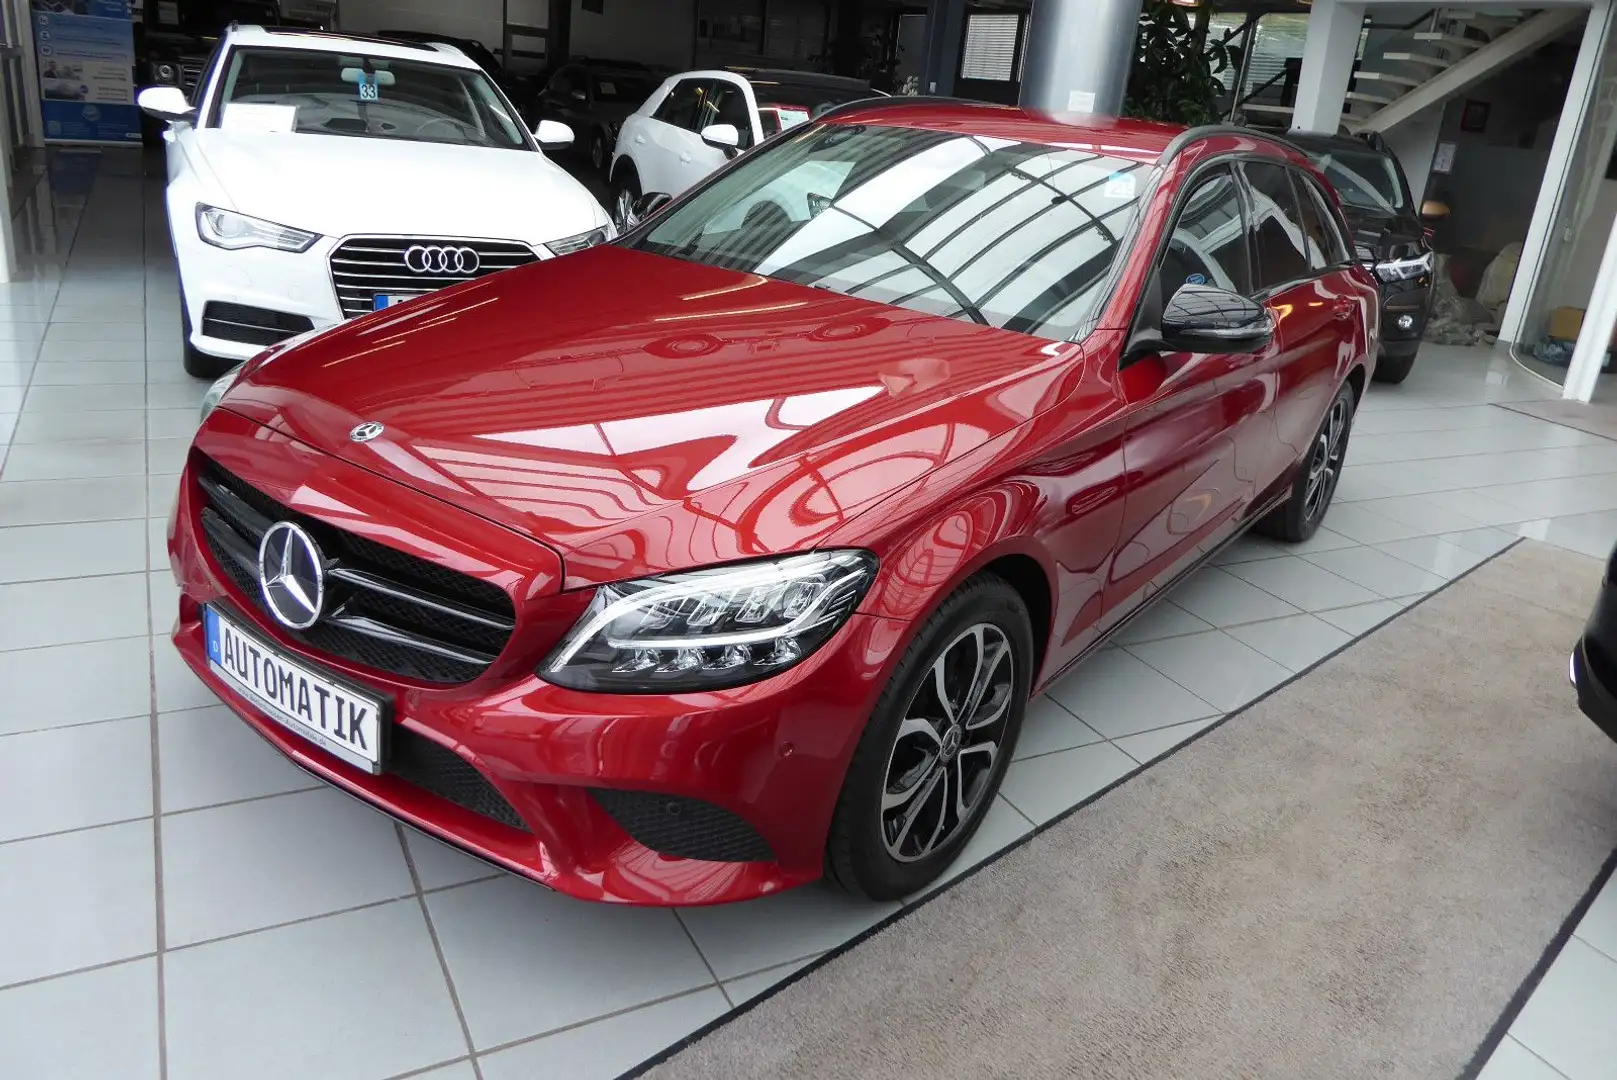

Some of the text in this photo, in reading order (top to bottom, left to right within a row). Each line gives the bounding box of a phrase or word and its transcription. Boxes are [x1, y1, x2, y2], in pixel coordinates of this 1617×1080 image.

[361, 84, 376, 99] 33
[212, 627, 369, 751] D AUTOMATIK
